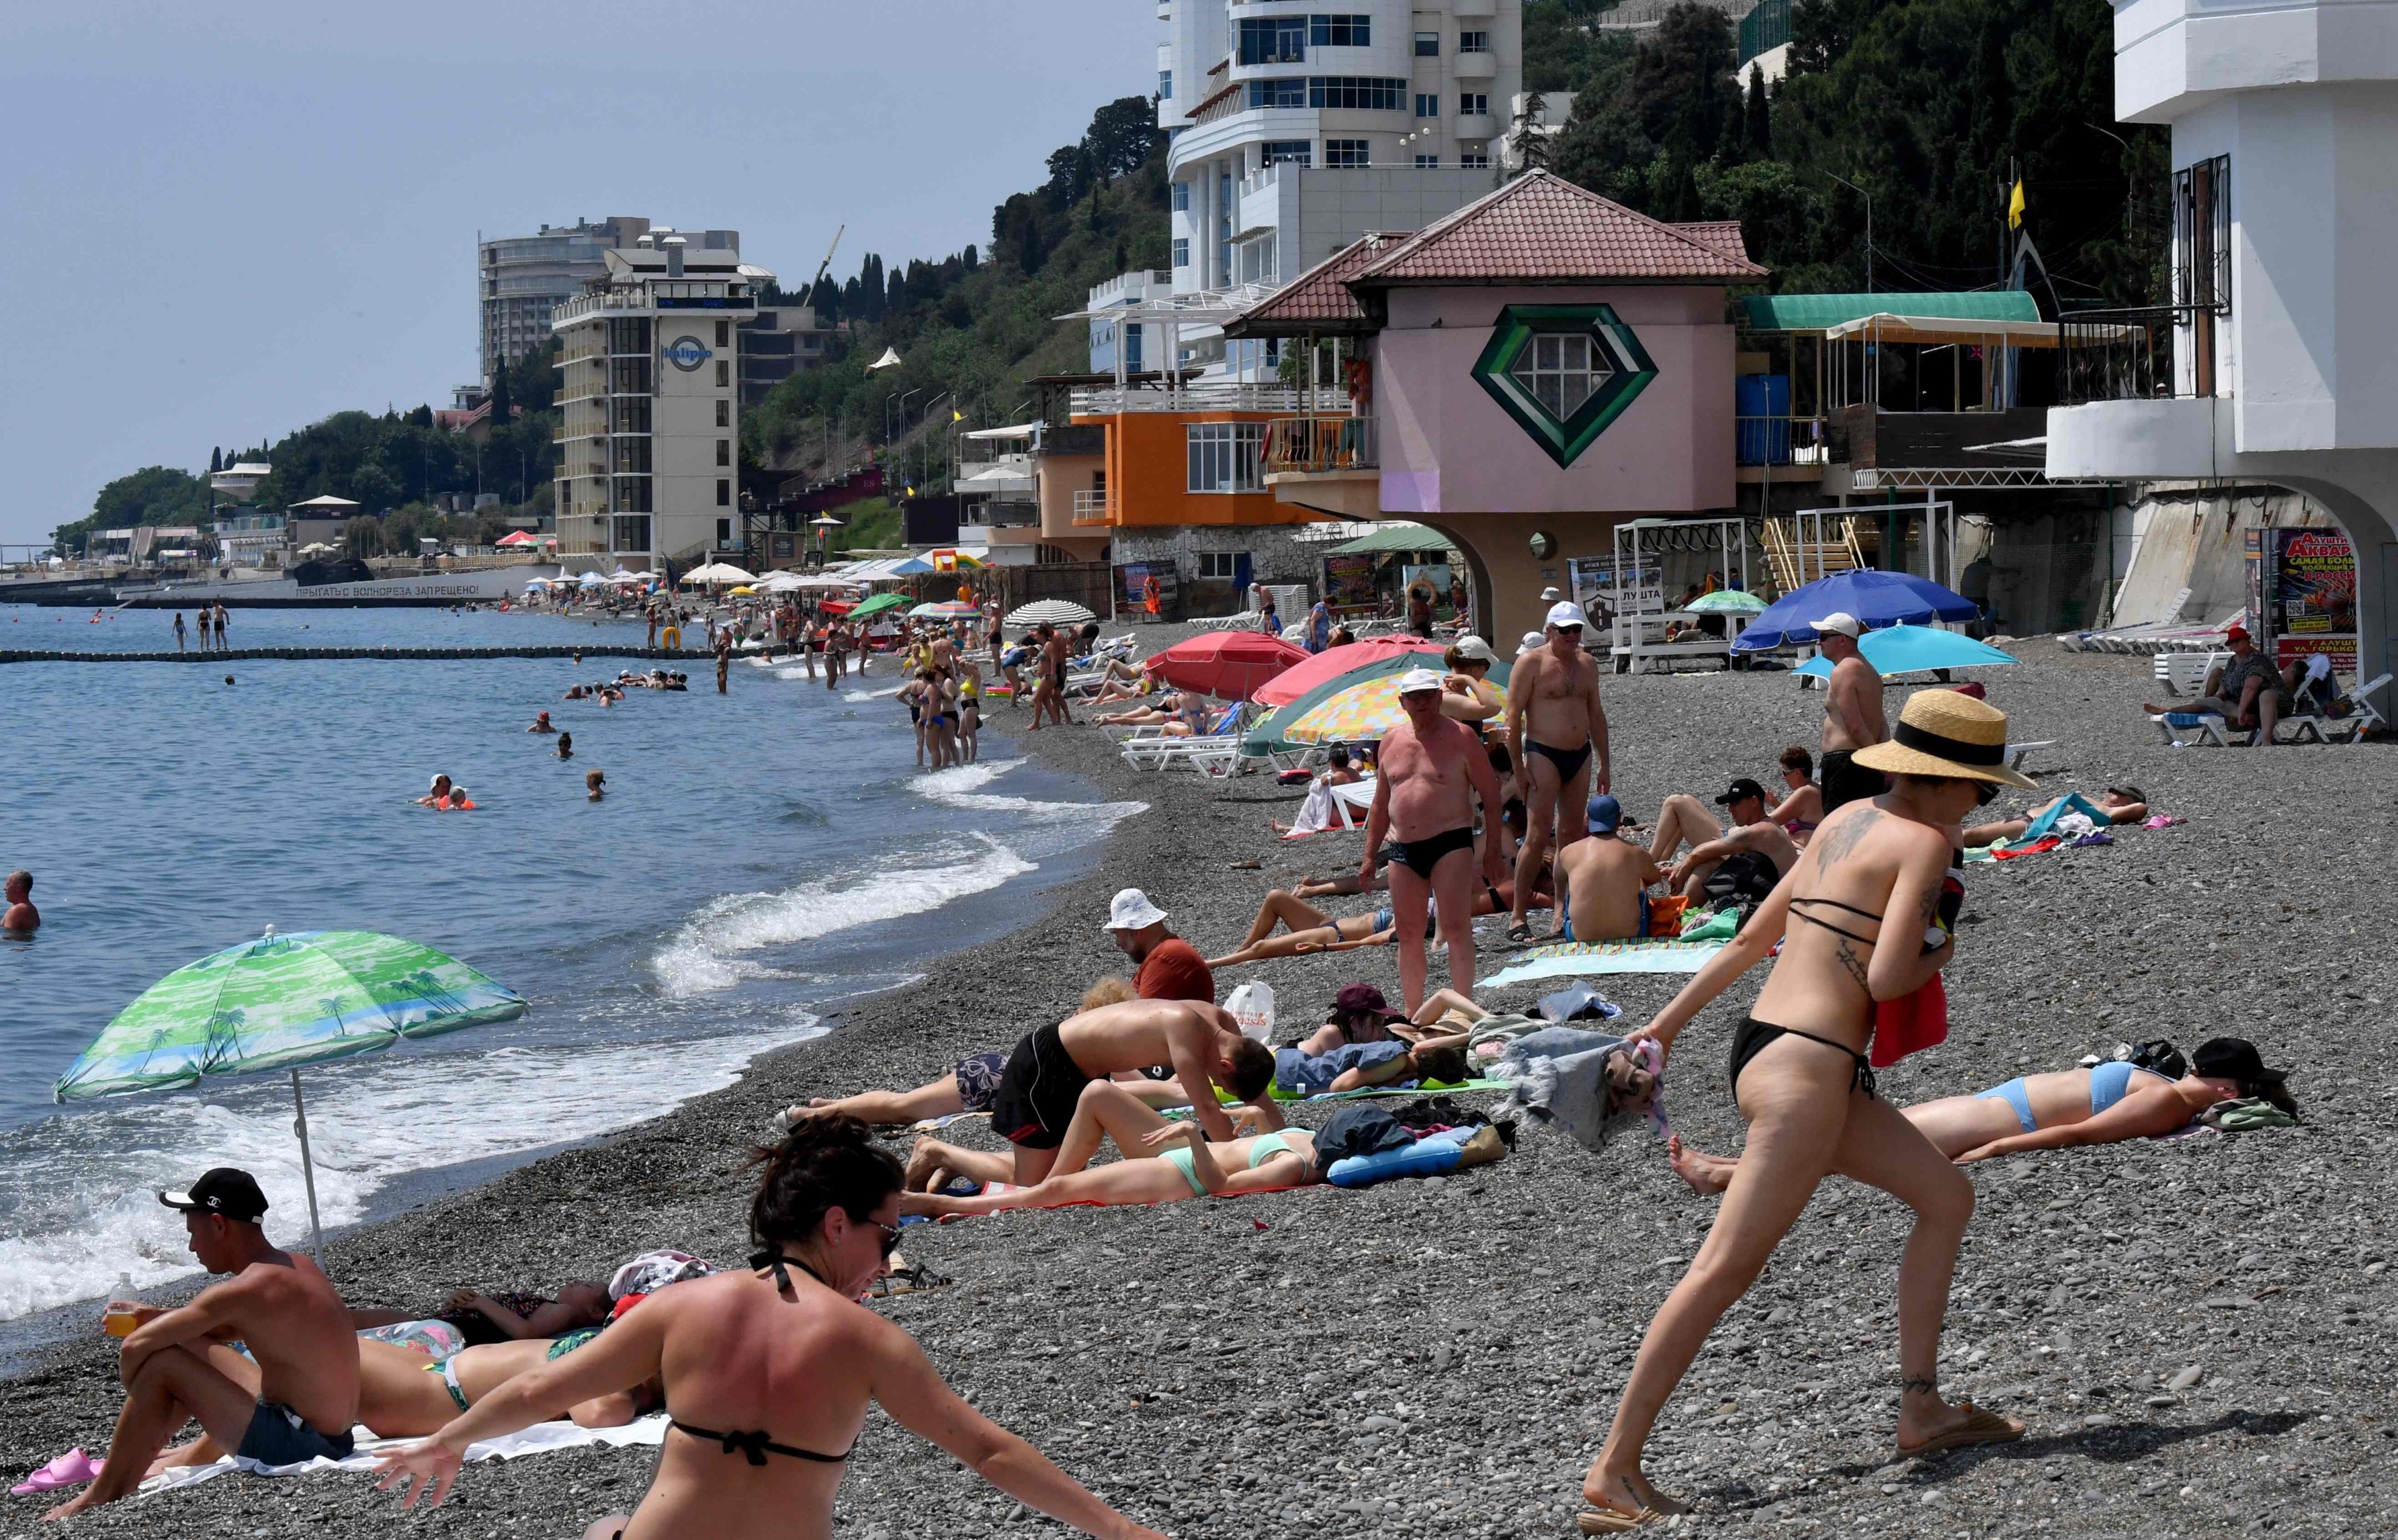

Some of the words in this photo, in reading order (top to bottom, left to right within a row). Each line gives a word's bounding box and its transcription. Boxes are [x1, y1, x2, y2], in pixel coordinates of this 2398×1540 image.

[664, 347, 713, 361] kalipso
[2304, 572, 2312, 581] В
[296, 588, 341, 597] ПРЫГАТЬ
[343, 587, 350, 597] С
[353, 587, 411, 597] ВОЛНОРЕЗА
[415, 585, 479, 596] ЗАПРЕЩЕНО!
